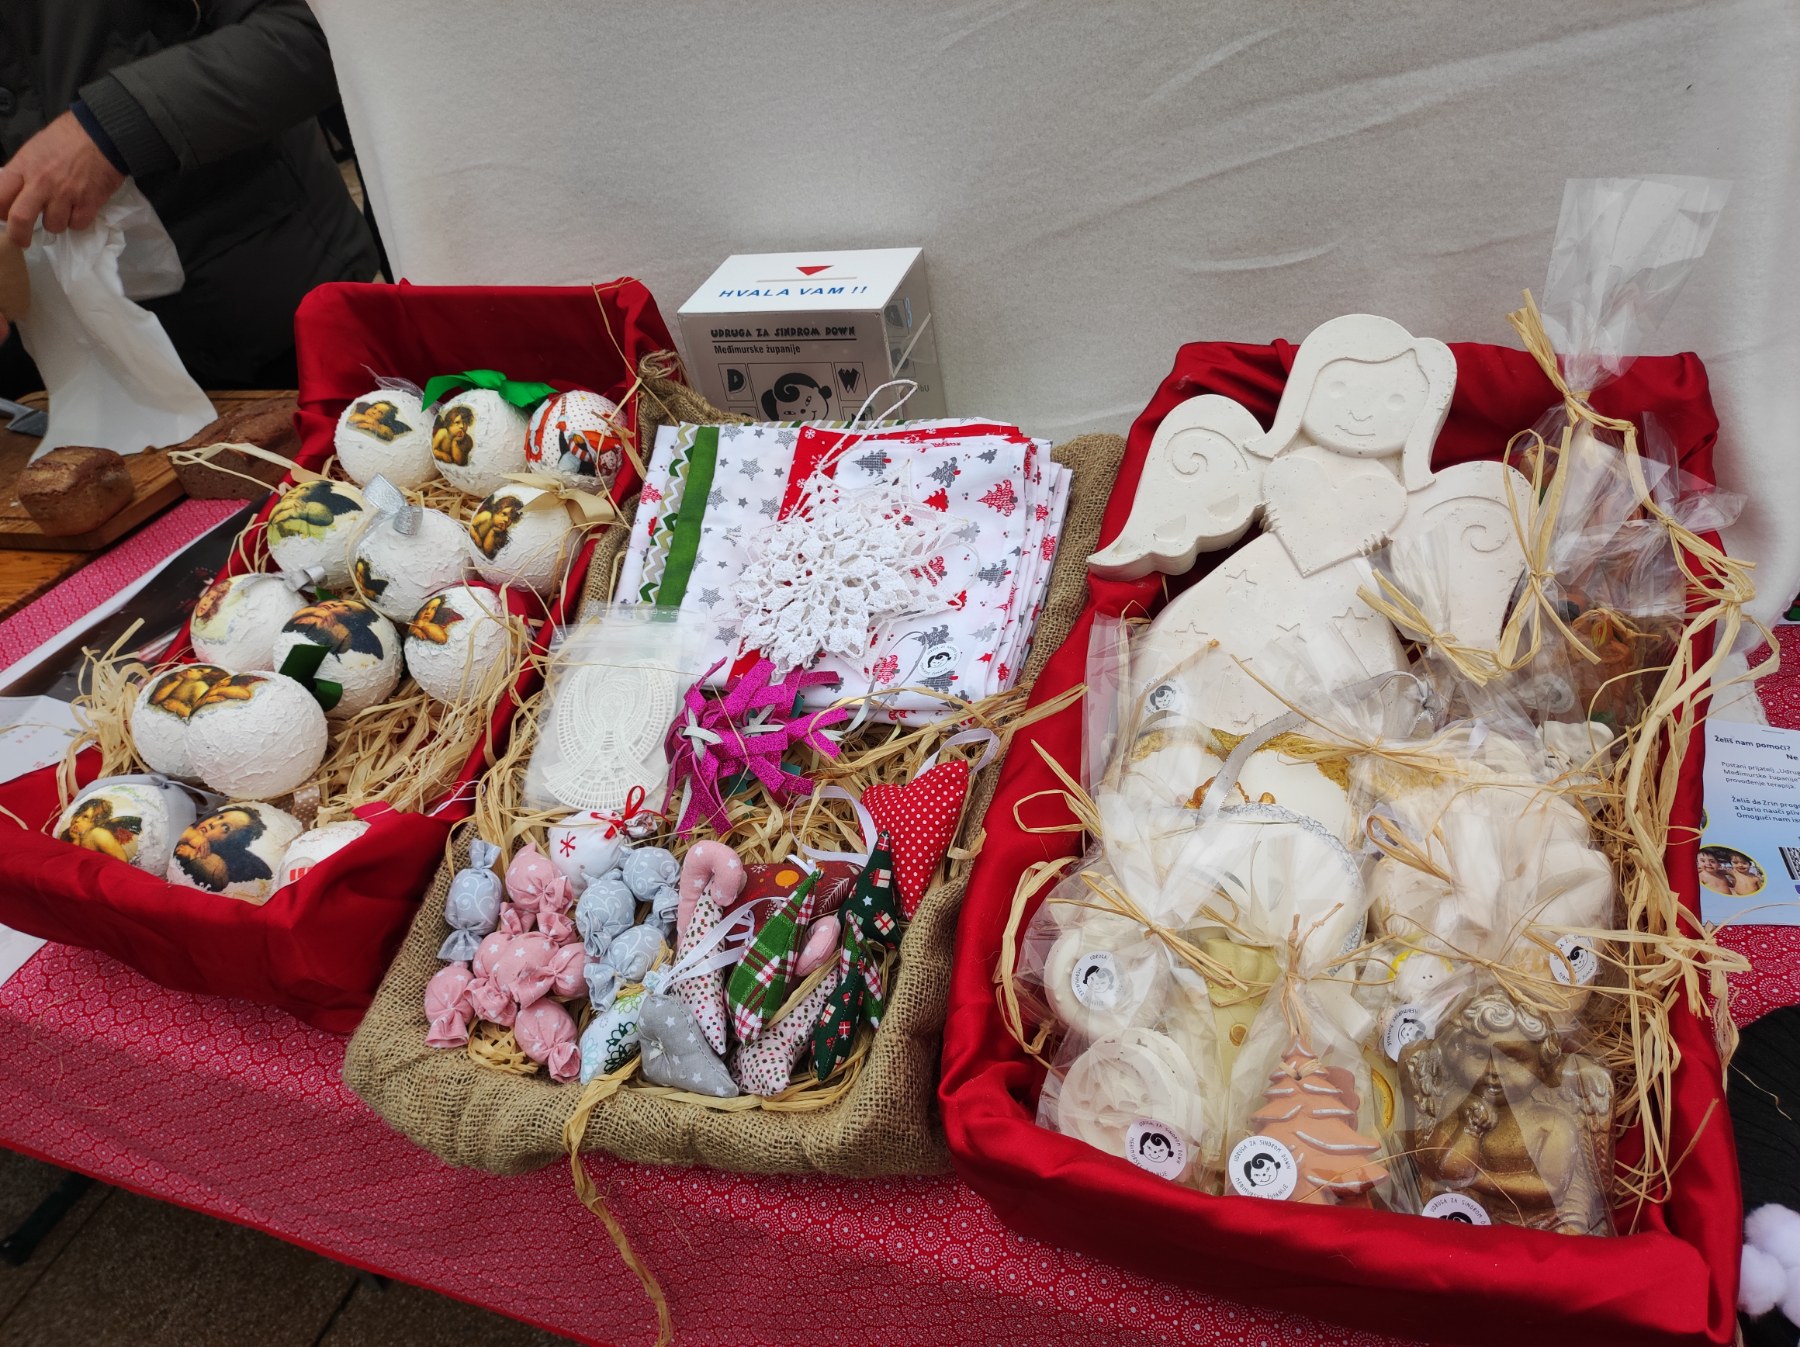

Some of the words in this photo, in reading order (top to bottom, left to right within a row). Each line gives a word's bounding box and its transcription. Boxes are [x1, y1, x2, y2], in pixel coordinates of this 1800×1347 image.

[718, 287, 790, 298] HVALA
[799, 286, 844, 296] VAM
[711, 328, 752, 338] UDRUGA
[756, 328, 770, 337] ZA
[774, 327, 820, 337] SINDROM
[825, 326, 856, 336] DOWN
[714, 345, 764, 355] Međimurske
[766, 344, 801, 355] županije
[727, 368, 747, 394] D
[837, 367, 861, 394] W
[1714, 734, 1734, 744] Želiš
[1756, 742, 1791, 751] pomoći?
[1721, 761, 1747, 770] Postani
[1748, 765, 1775, 774] prijatelj
[1736, 812, 1772, 821] Omogući
[1259, 1139, 1282, 1153] SINDROM
[1461, 1200, 1482, 1219] SINDROM
